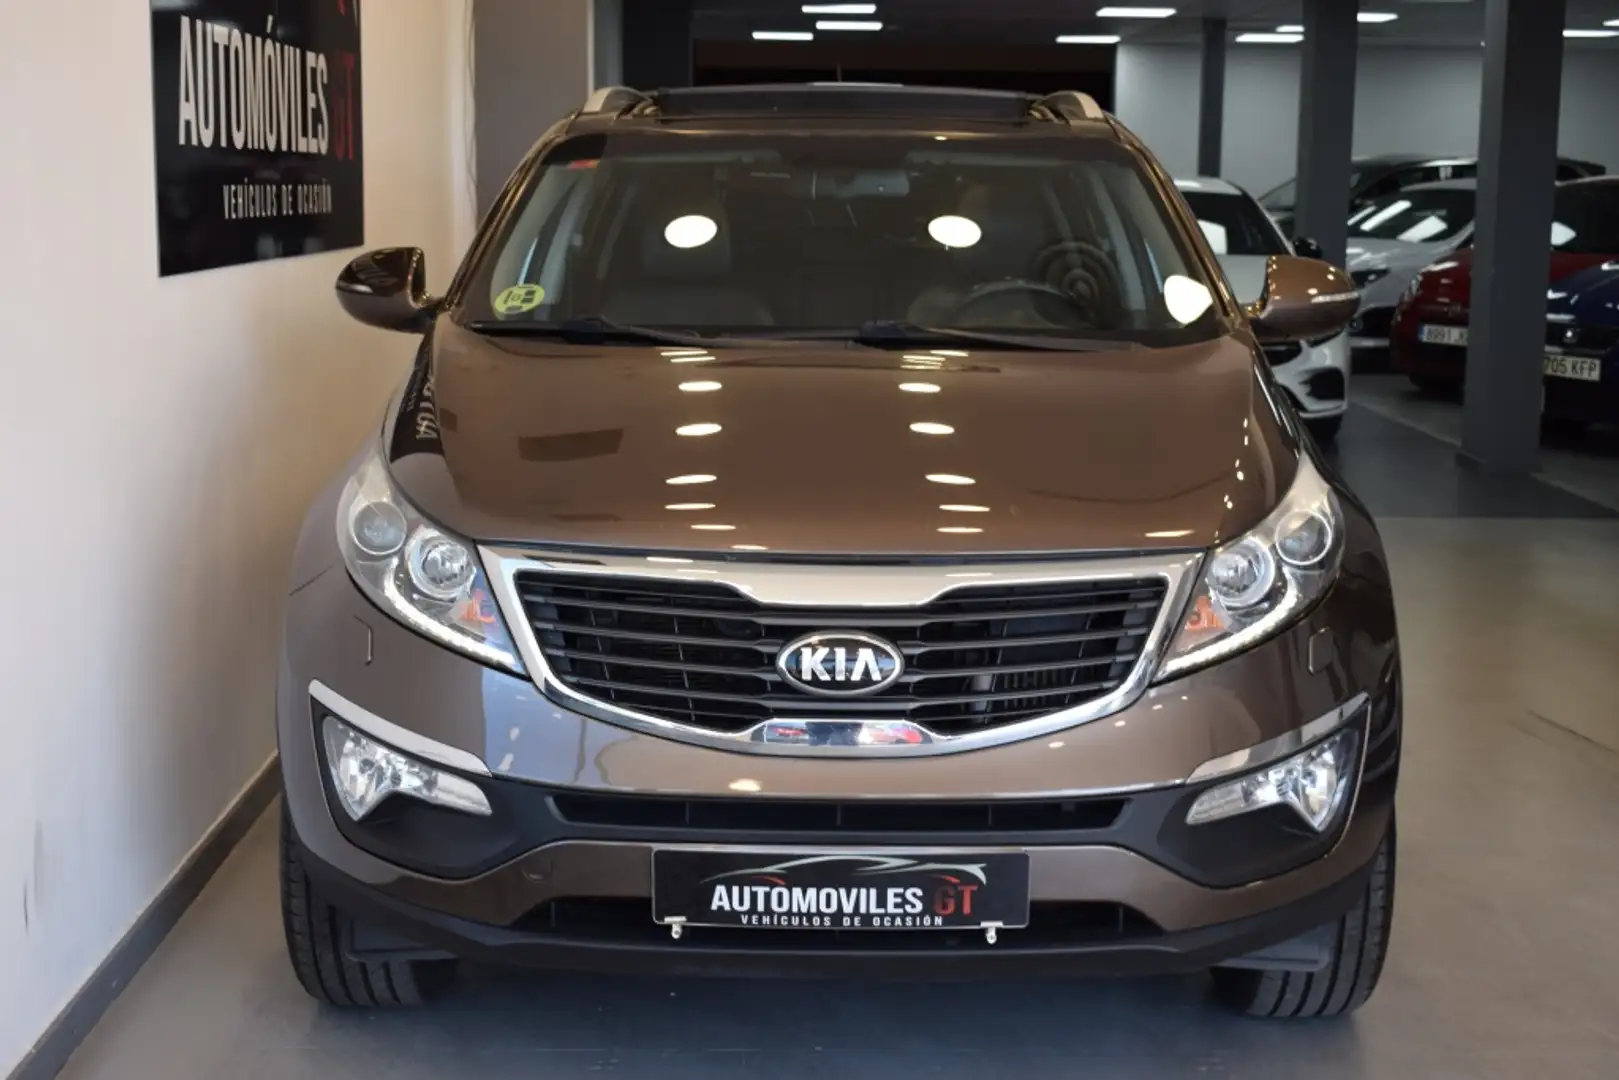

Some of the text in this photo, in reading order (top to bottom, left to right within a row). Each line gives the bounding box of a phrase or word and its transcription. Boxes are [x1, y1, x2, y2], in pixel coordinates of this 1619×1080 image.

[178, 14, 329, 156] AUTOMÓVILES
[222, 177, 277, 220] VEHÍCULOS
[282, 184, 293, 216] DE
[801, 647, 882, 681] KIA
[711, 885, 978, 917] AUTOMOVILES GT
[741, 913, 943, 927] VEHÍCULOS DE OCASIÓN
